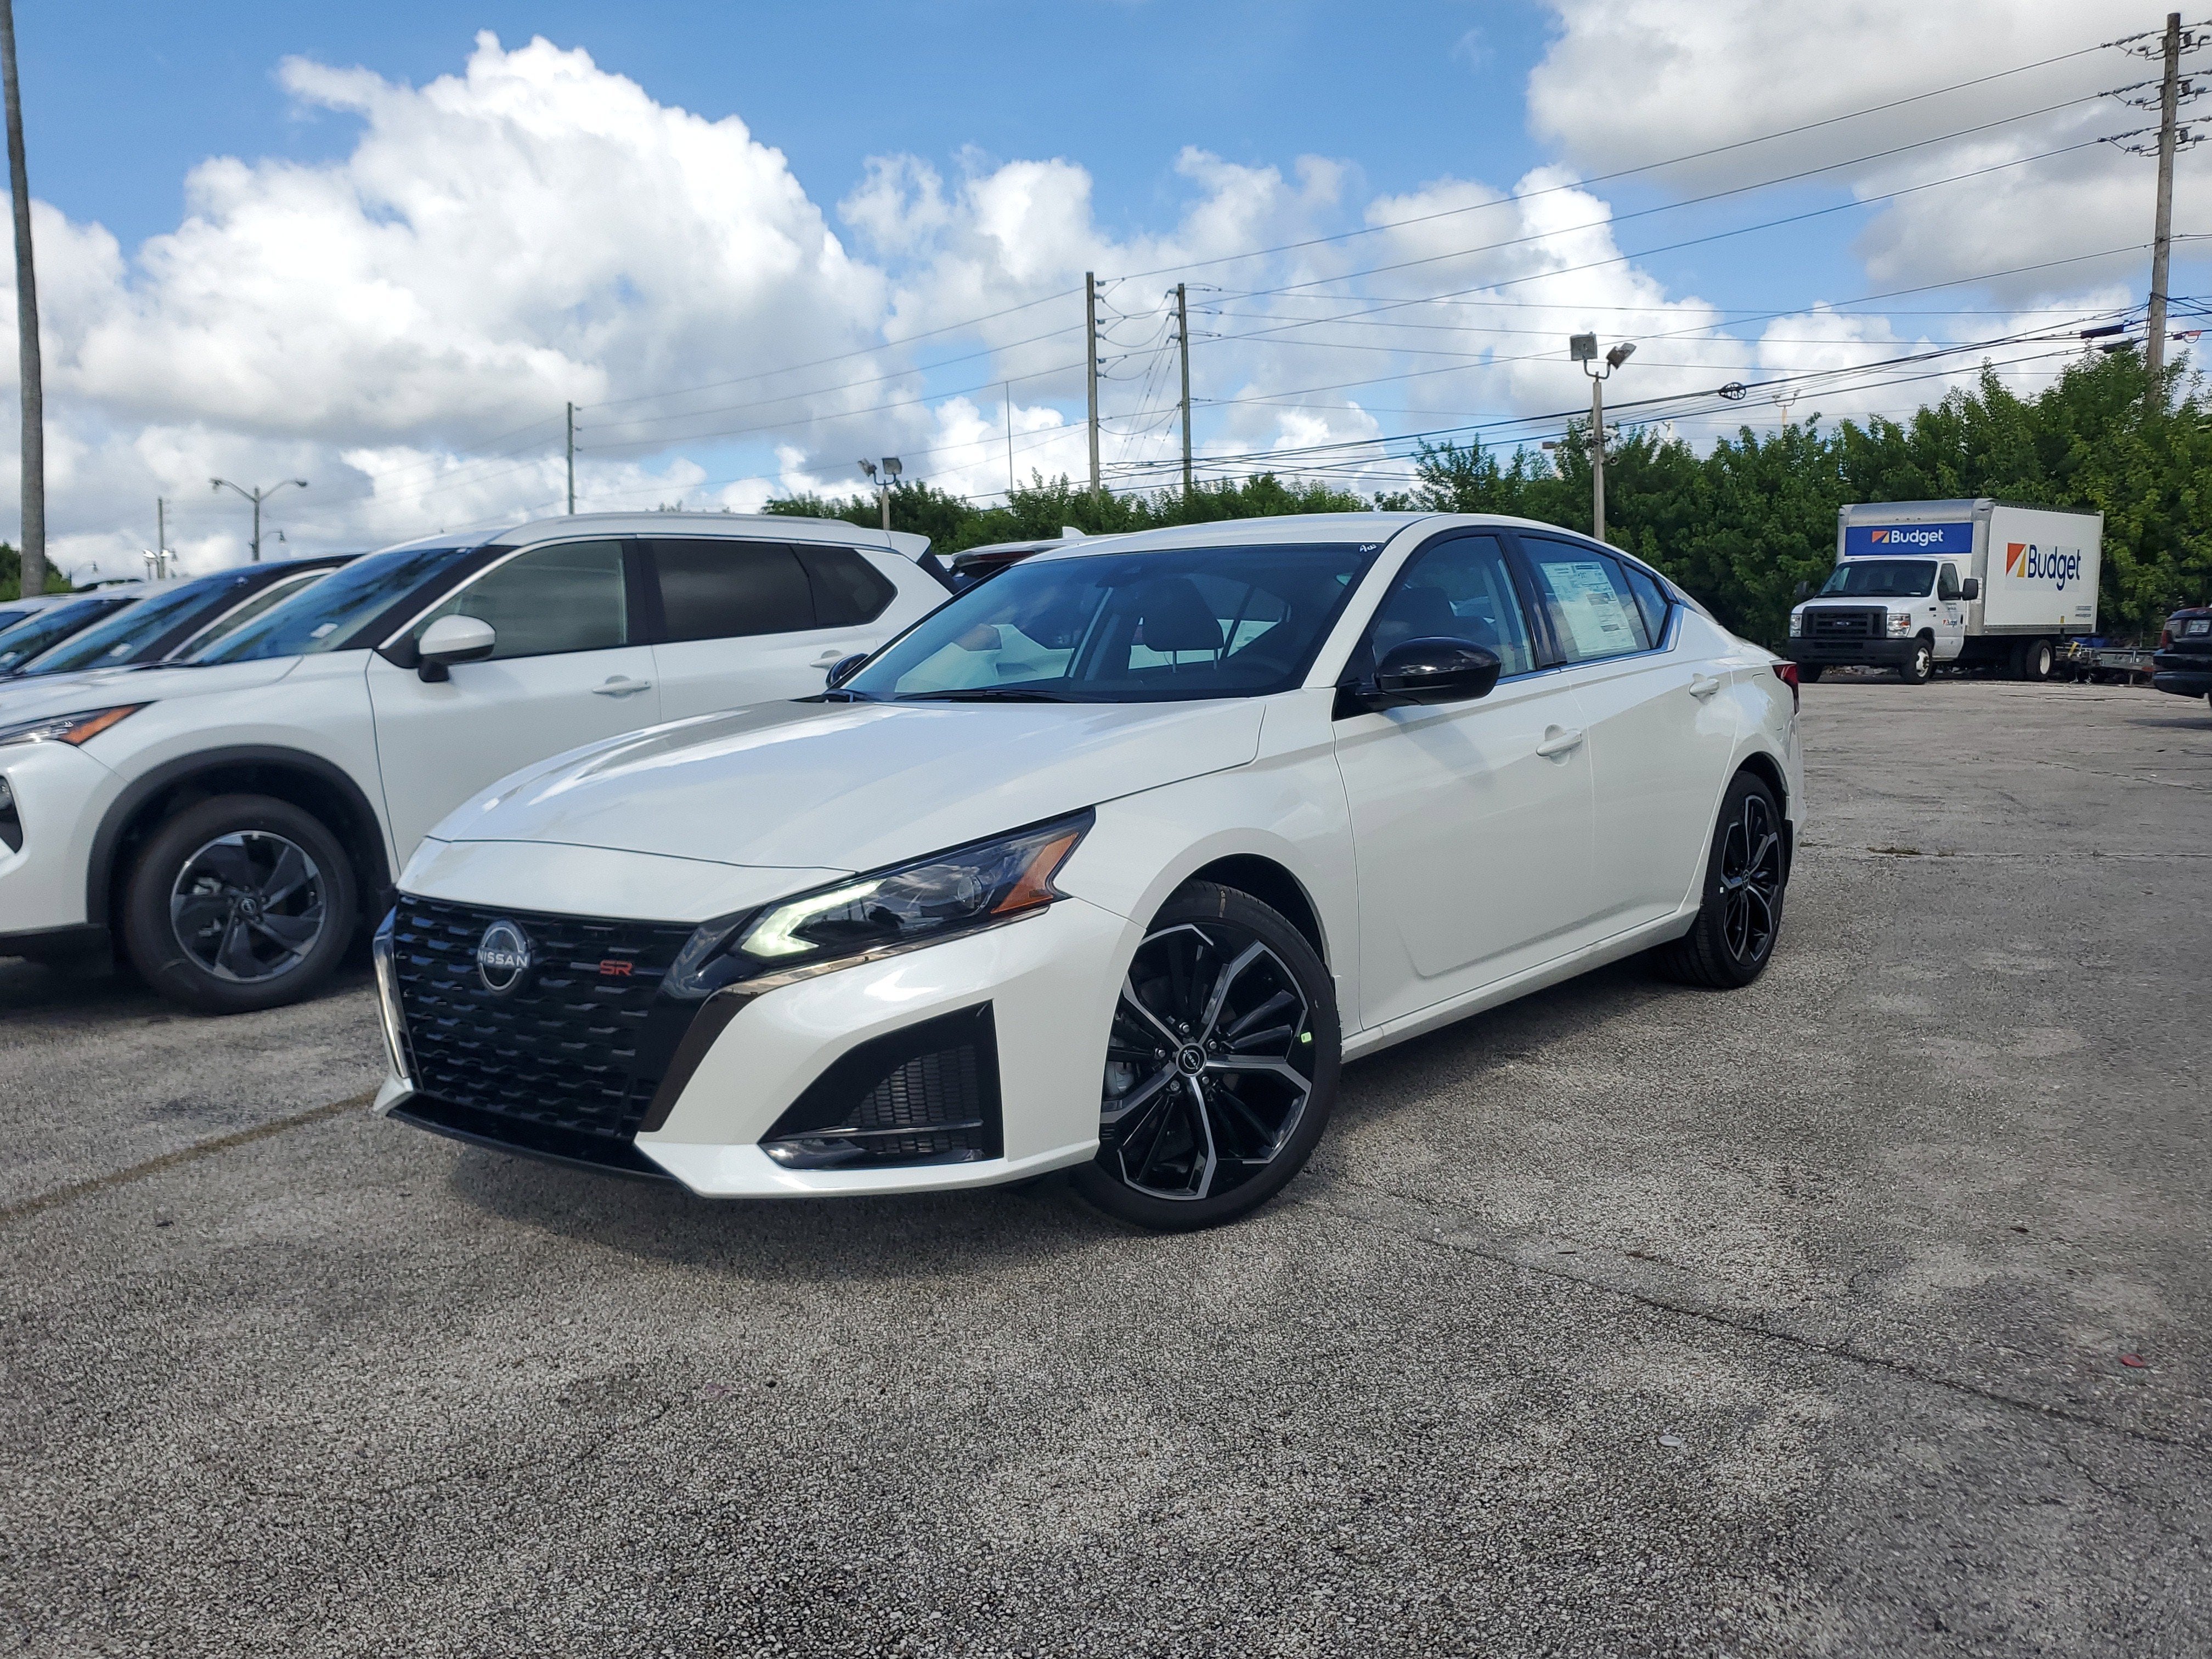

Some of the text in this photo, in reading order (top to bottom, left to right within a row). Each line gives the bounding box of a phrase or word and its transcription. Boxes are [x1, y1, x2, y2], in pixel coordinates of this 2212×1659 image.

[1891, 529, 1943, 546] Budget
[2028, 544, 2081, 591] Budget
[478, 950, 528, 967] NISSAN
[600, 960, 633, 976] SR
[1184, 1049, 1199, 1070] NISSAN
